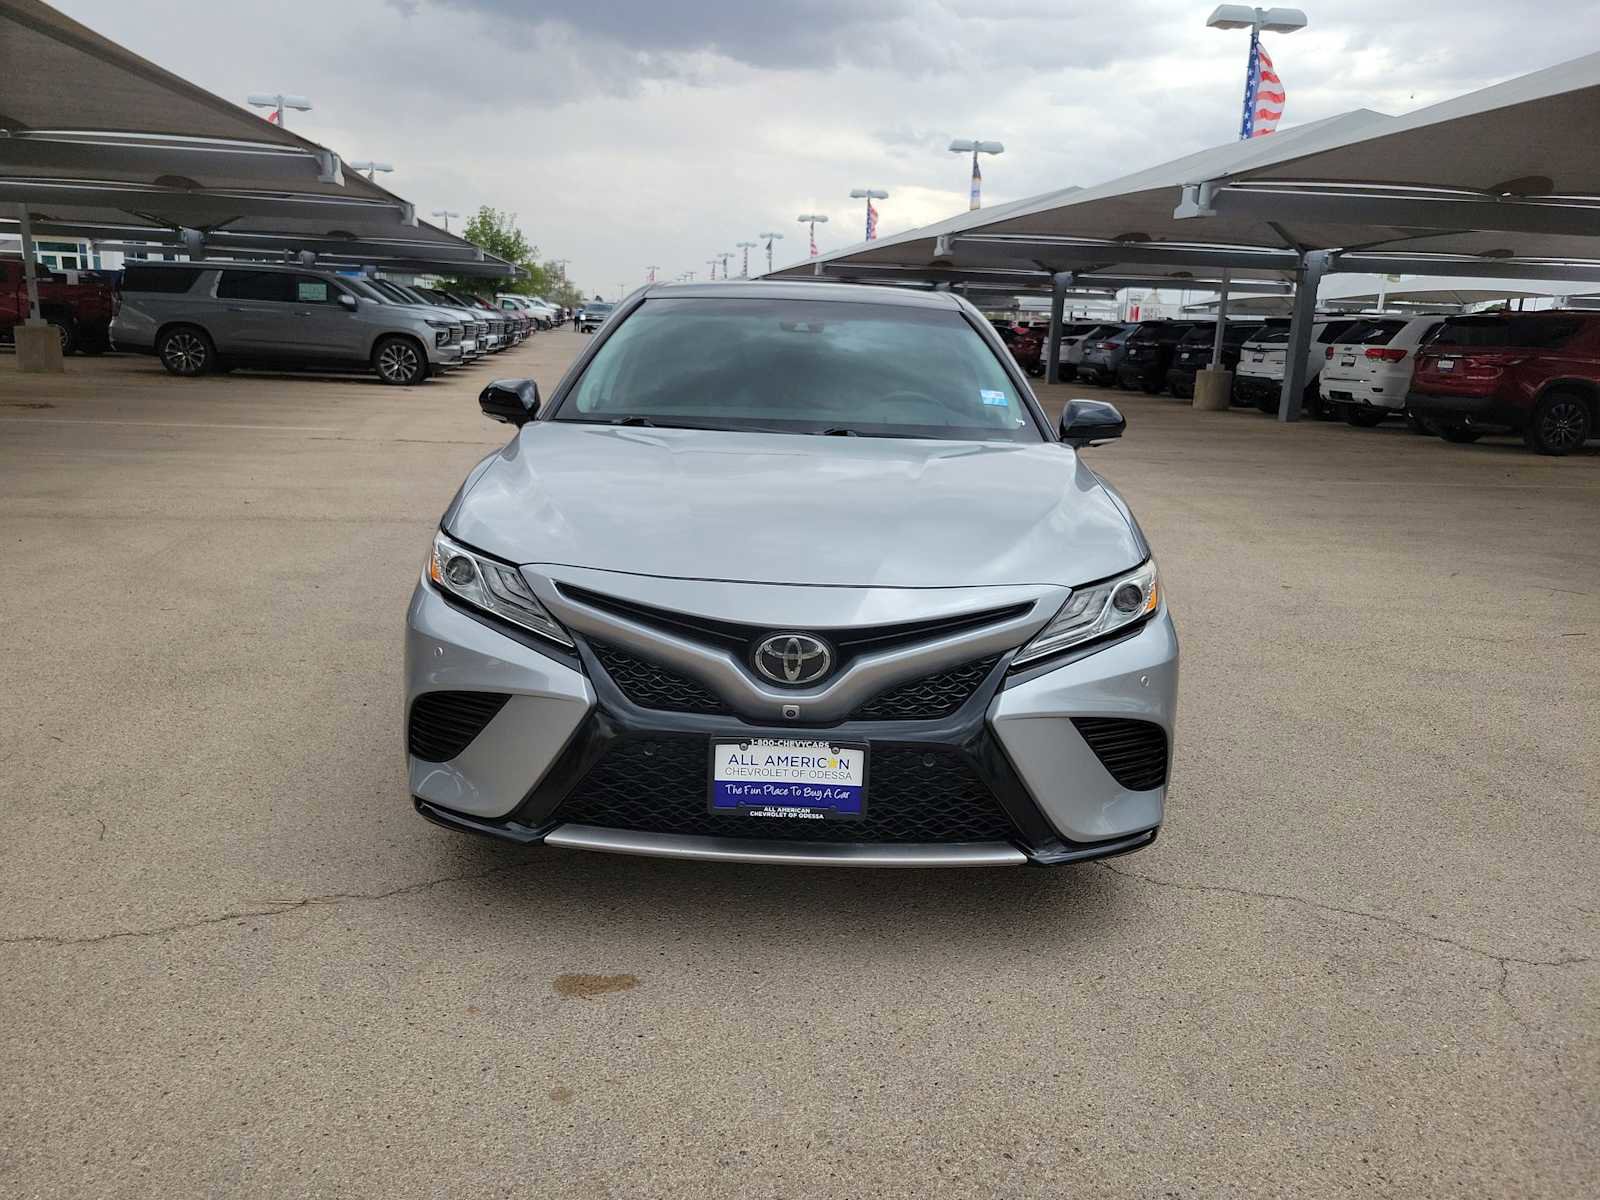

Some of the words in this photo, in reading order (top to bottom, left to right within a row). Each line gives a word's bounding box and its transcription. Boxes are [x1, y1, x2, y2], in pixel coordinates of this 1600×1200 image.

[728, 753, 759, 766] ALL
[725, 767, 788, 777] CHEVROLET
[792, 769, 806, 778] OF
[809, 770, 852, 780] ODESSA
[725, 783, 743, 795] The
[744, 784, 761, 795] Fun
[763, 784, 789, 796] Place
[790, 785, 802, 796] To
[803, 787, 822, 801] Buy
[823, 788, 832, 799] A
[834, 788, 850, 799] Car
